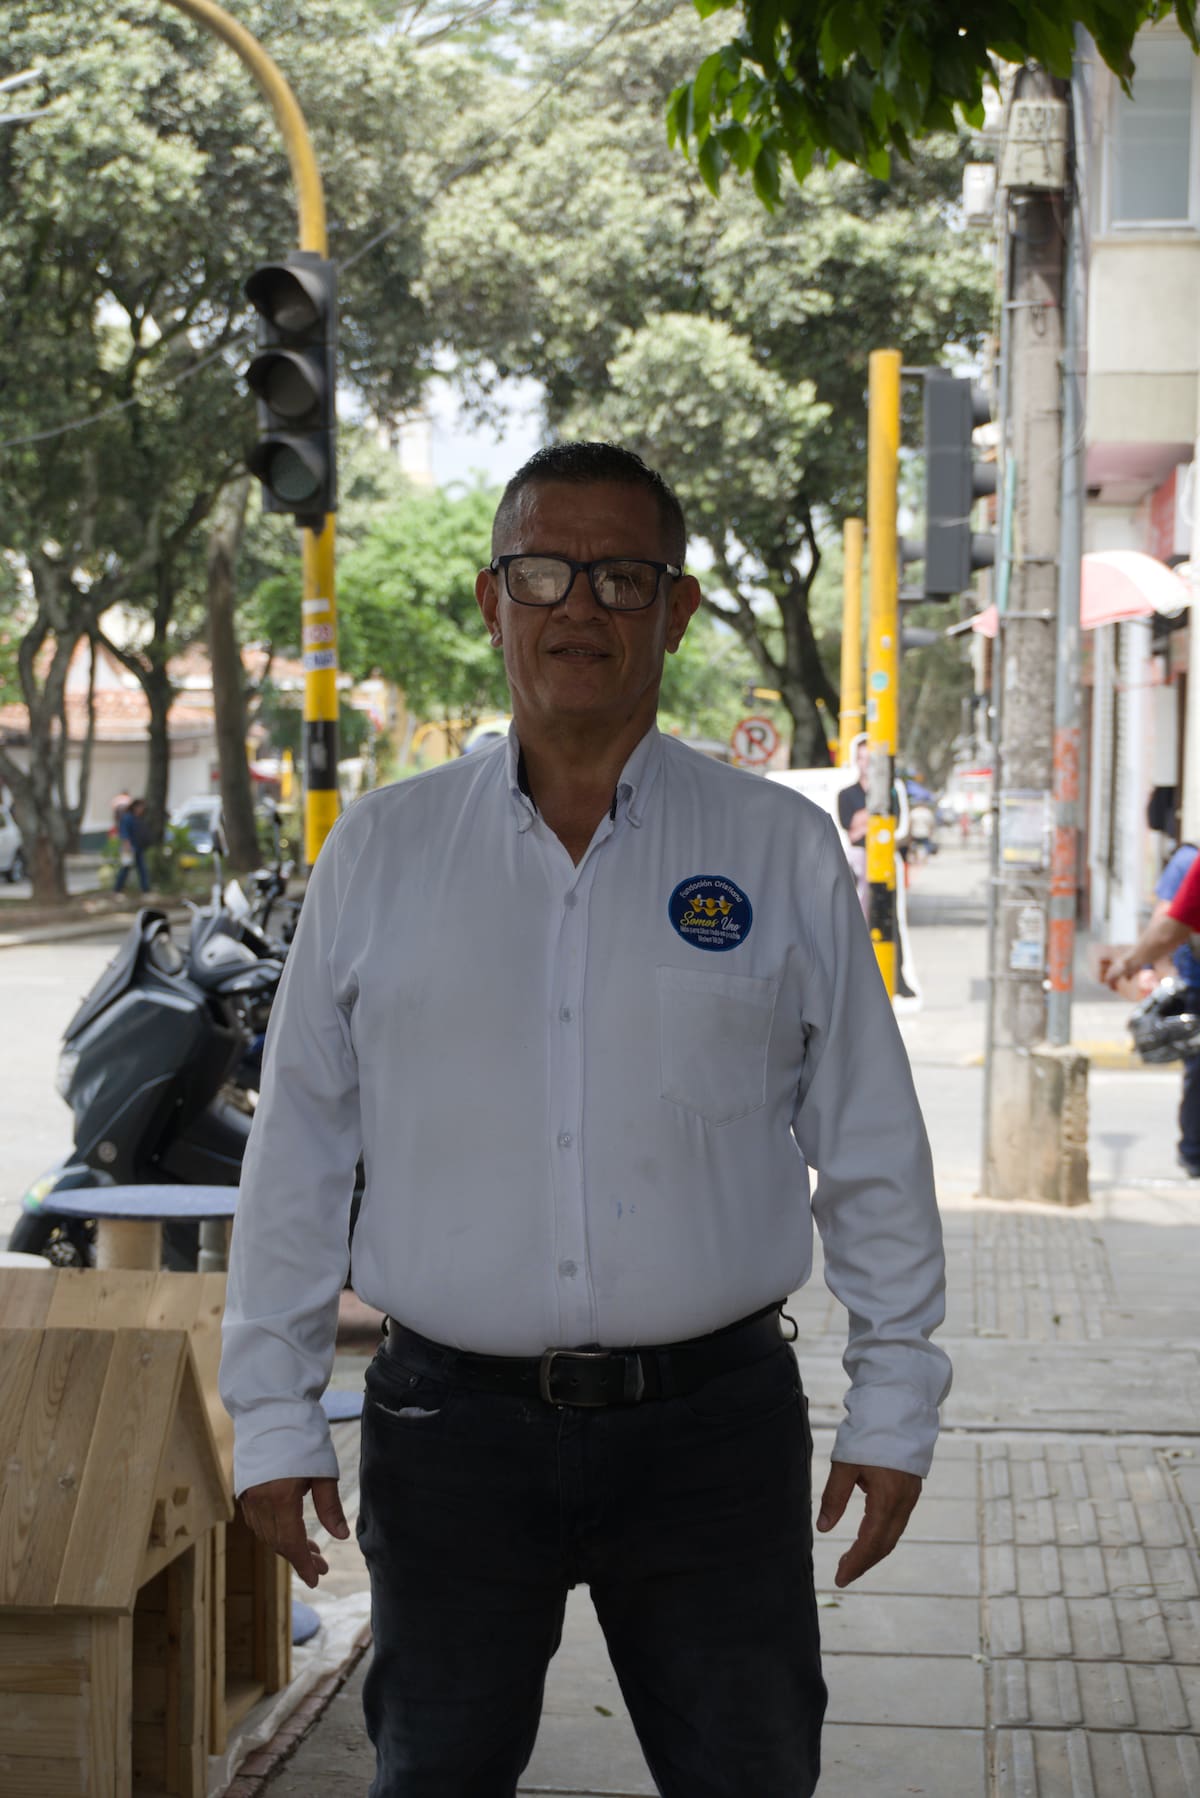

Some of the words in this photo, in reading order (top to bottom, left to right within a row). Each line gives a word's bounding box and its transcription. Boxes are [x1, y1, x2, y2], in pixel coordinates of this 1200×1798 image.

[746, 726, 767, 754] P
[680, 911, 719, 927] Somos
[721, 916, 741, 931] Uno
